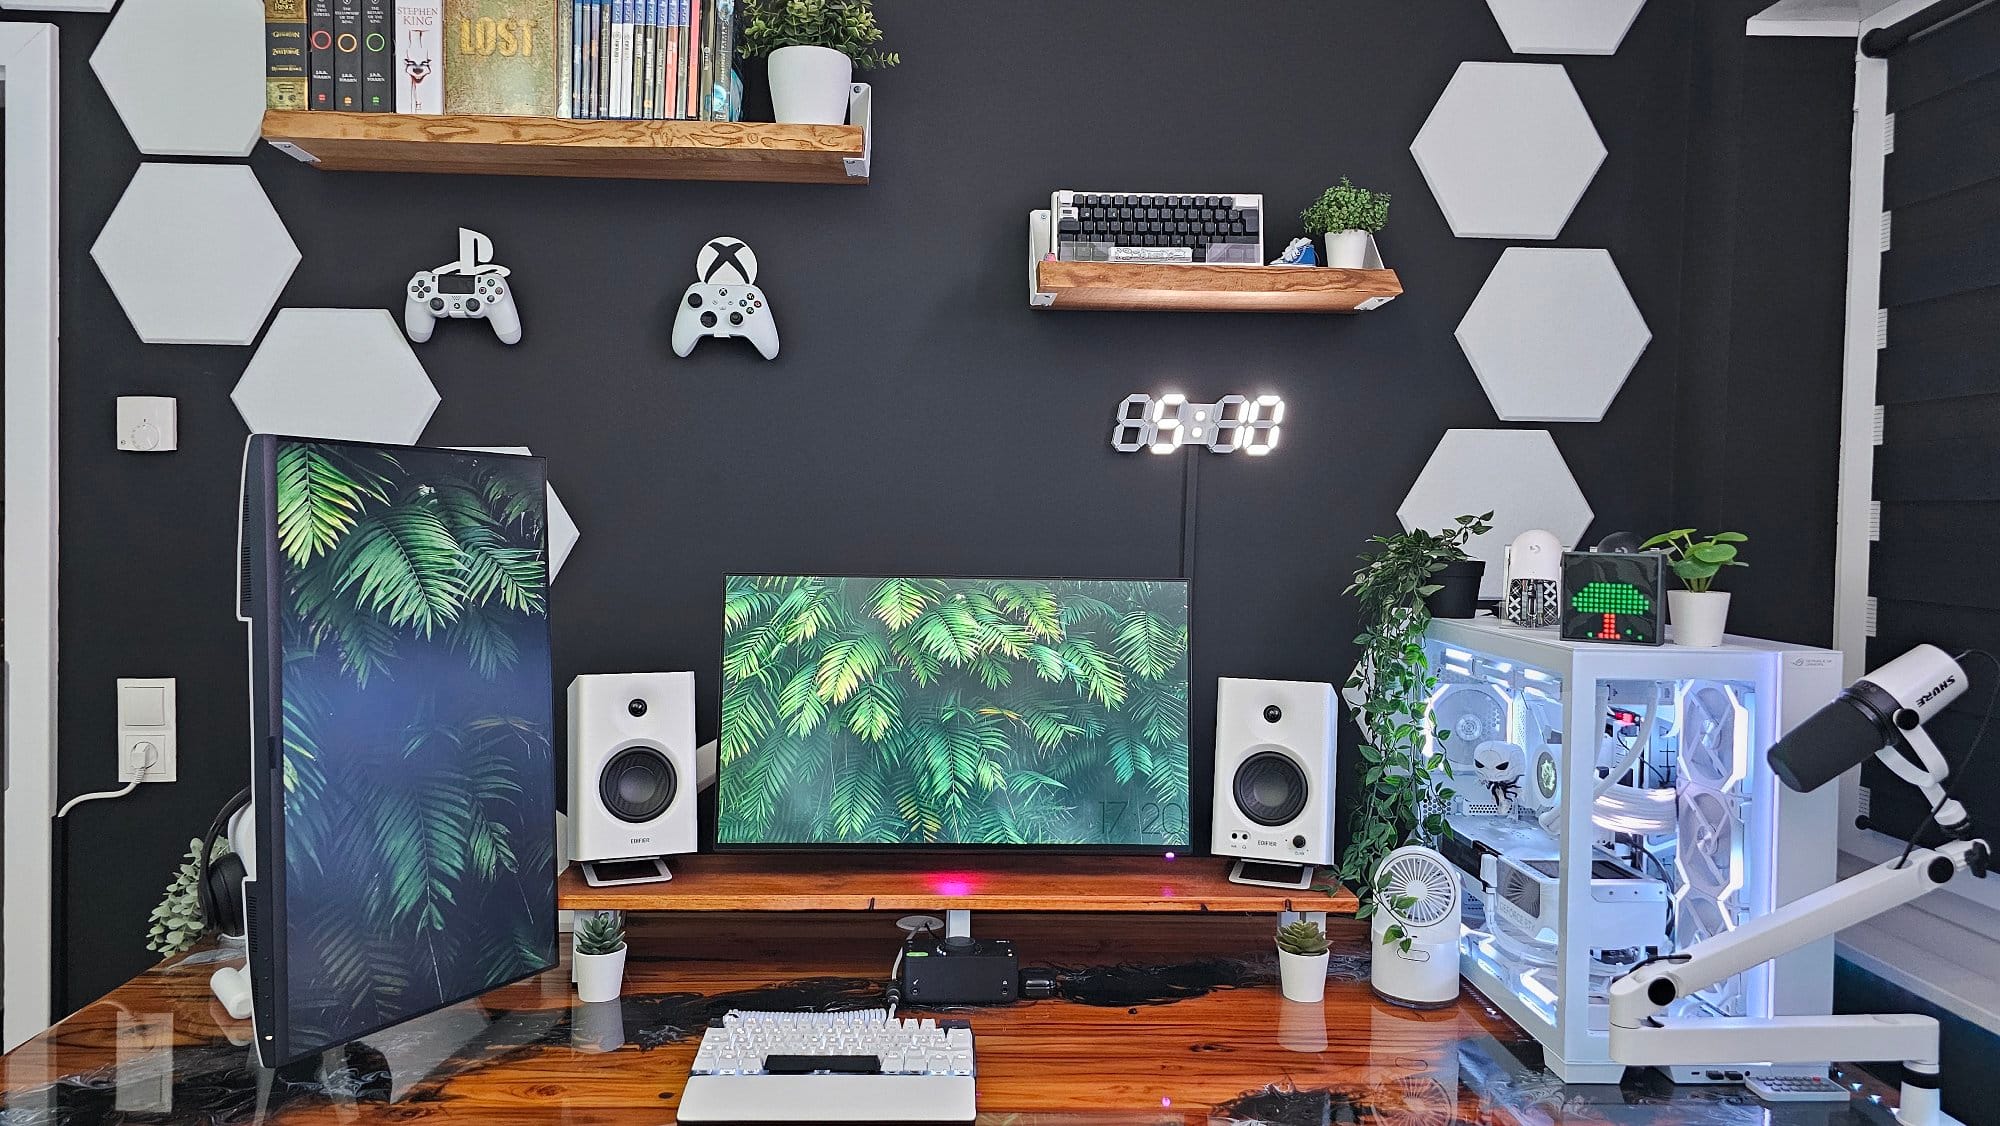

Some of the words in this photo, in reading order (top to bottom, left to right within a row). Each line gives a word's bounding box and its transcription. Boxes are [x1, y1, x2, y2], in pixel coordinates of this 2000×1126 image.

[397, 7, 438, 16] STEPHEN
[403, 16, 433, 26] KING
[408, 29, 431, 48] IT
[459, 16, 538, 57] LOST
[1915, 675, 1956, 708] SHURE
